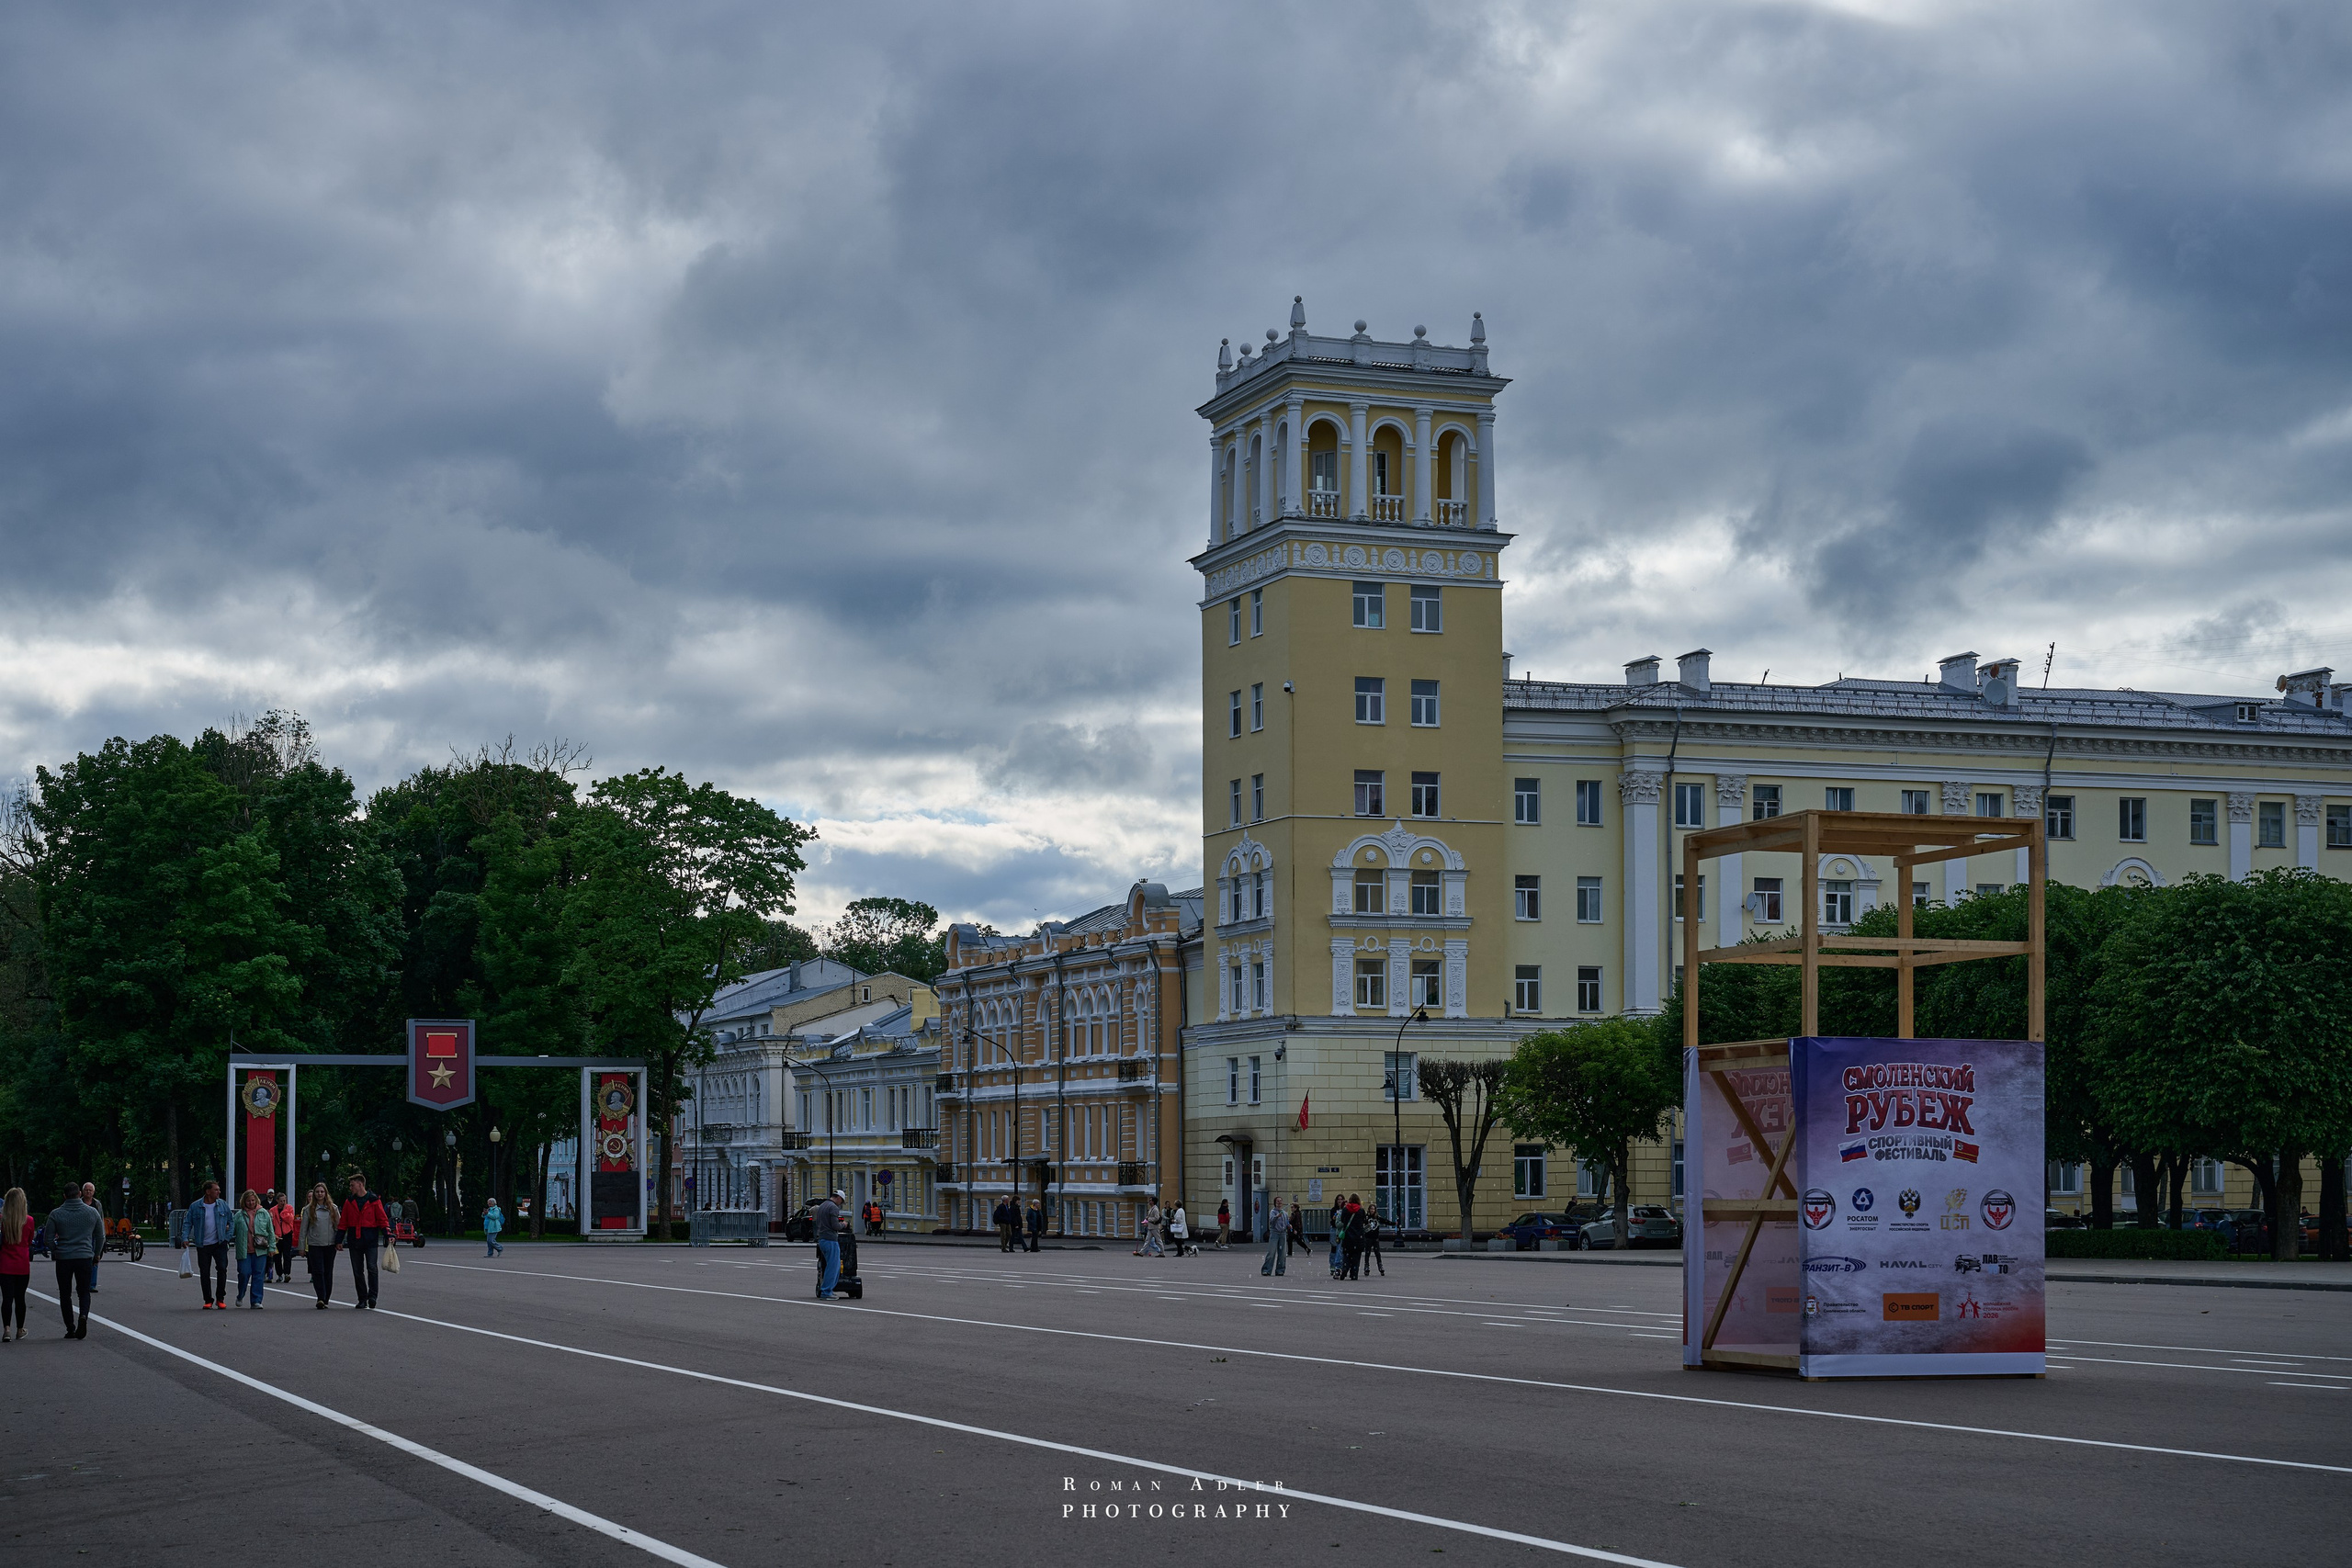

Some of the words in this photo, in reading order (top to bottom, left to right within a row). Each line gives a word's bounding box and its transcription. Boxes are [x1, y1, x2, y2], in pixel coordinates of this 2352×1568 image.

[259, 1078, 276, 1089] ЛЕНИН
[1843, 1064, 1975, 1093] СМОЛЕНСКИЙ
[615, 1083, 630, 1094] ЛЕНИН
[1845, 1089, 1975, 1135] РУБЕЖ
[1868, 1134, 1953, 1150] СПОРТИВНЫЙ
[1874, 1147, 1947, 1162] ФЕСТИВАЛЬ
[1880, 1260, 1927, 1269] HAVAL
[1982, 1254, 1998, 1264] ЛАВ
